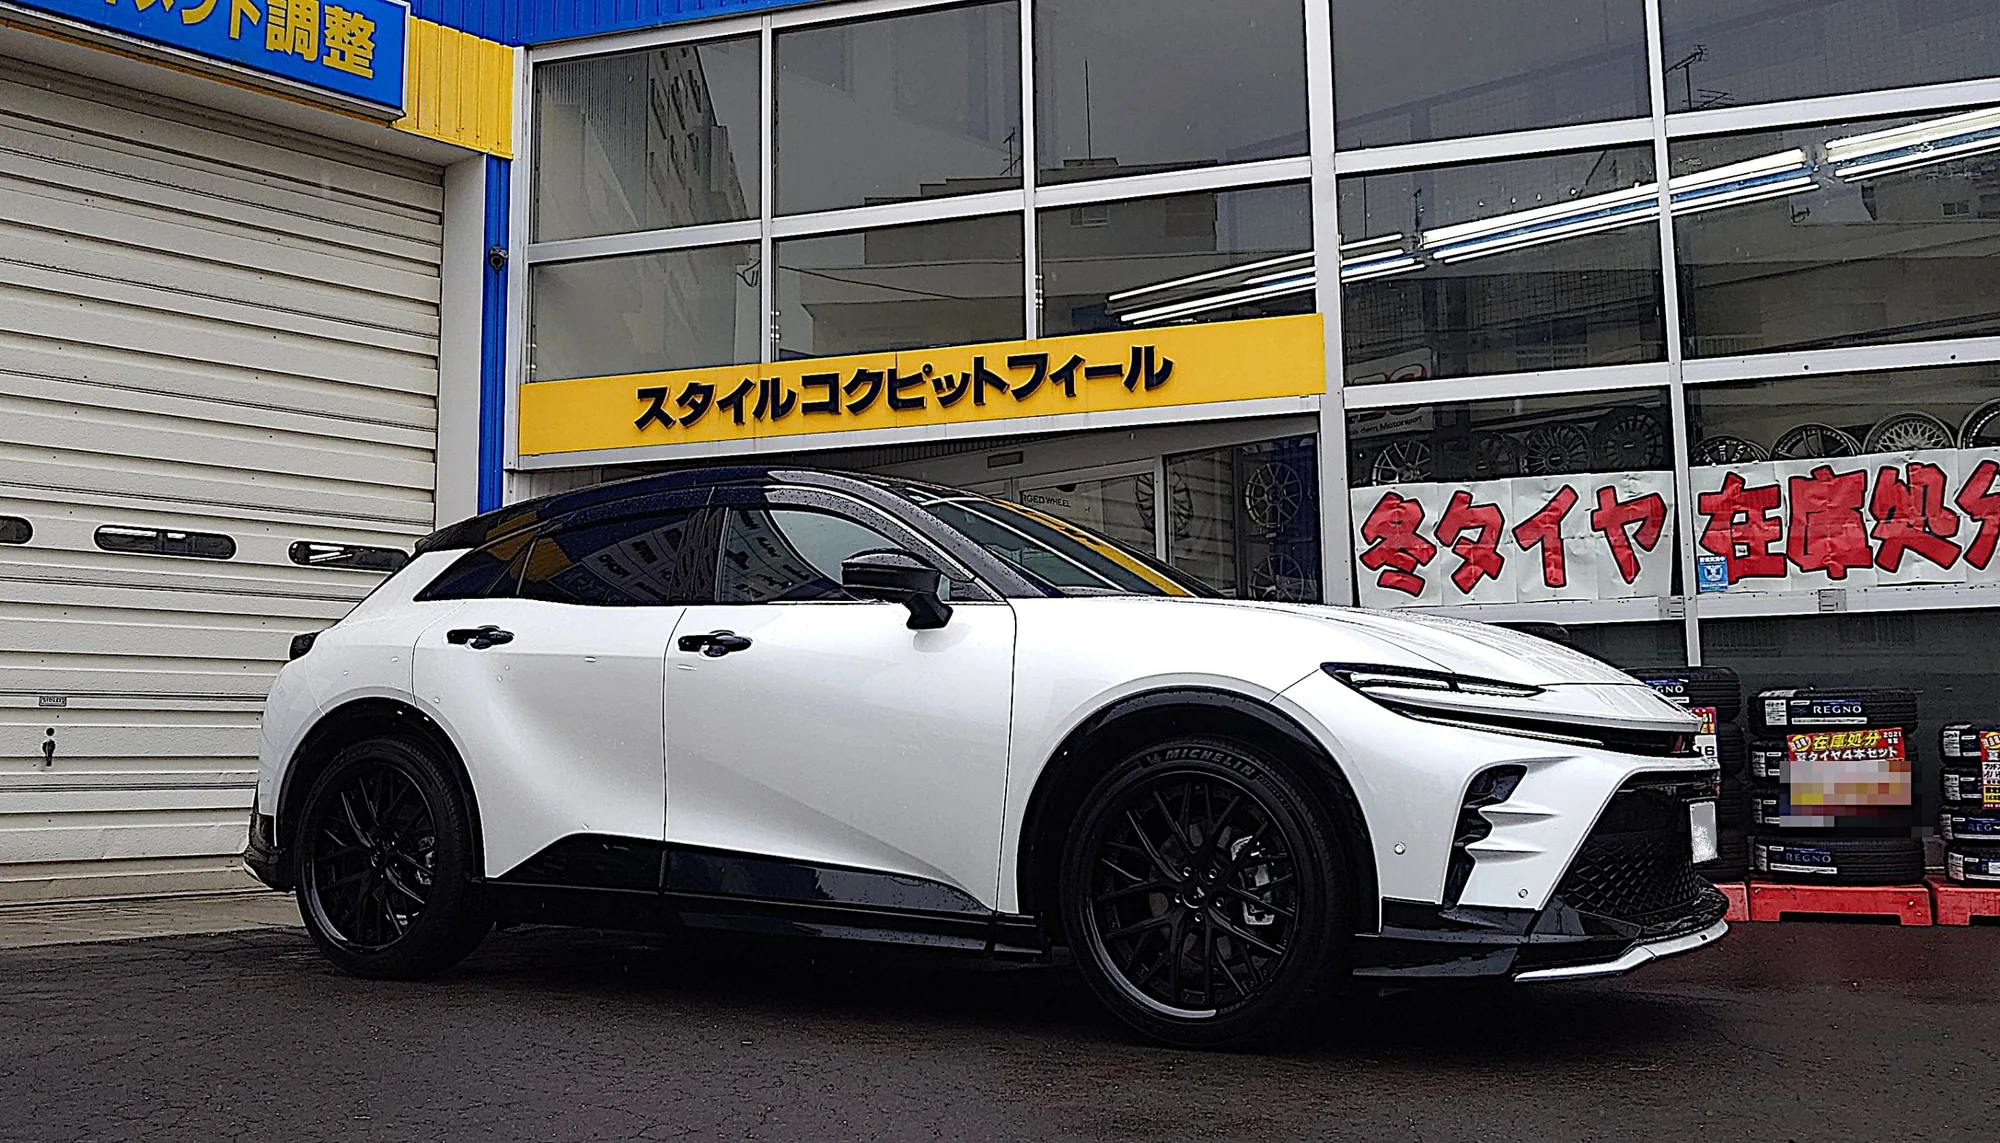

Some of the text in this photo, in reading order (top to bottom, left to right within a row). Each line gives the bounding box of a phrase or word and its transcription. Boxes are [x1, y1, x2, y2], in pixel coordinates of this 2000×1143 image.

[633, 344, 1174, 432] スタイルコクピットフィール
[1379, 414, 1423, 431] Motorsport
[1046, 497, 1071, 508] WHEEL
[1359, 483, 1668, 598] 冬タイヤ
[1655, 685, 1684, 693] GNO
[1813, 705, 1862, 714] REGNO
[1813, 731, 1881, 750] 在庫処分
[1882, 731, 1902, 739] 2021
[1164, 748, 1257, 777] MICHELIN
[1968, 823, 1992, 831] REG
[1786, 852, 1832, 863] REGNO
